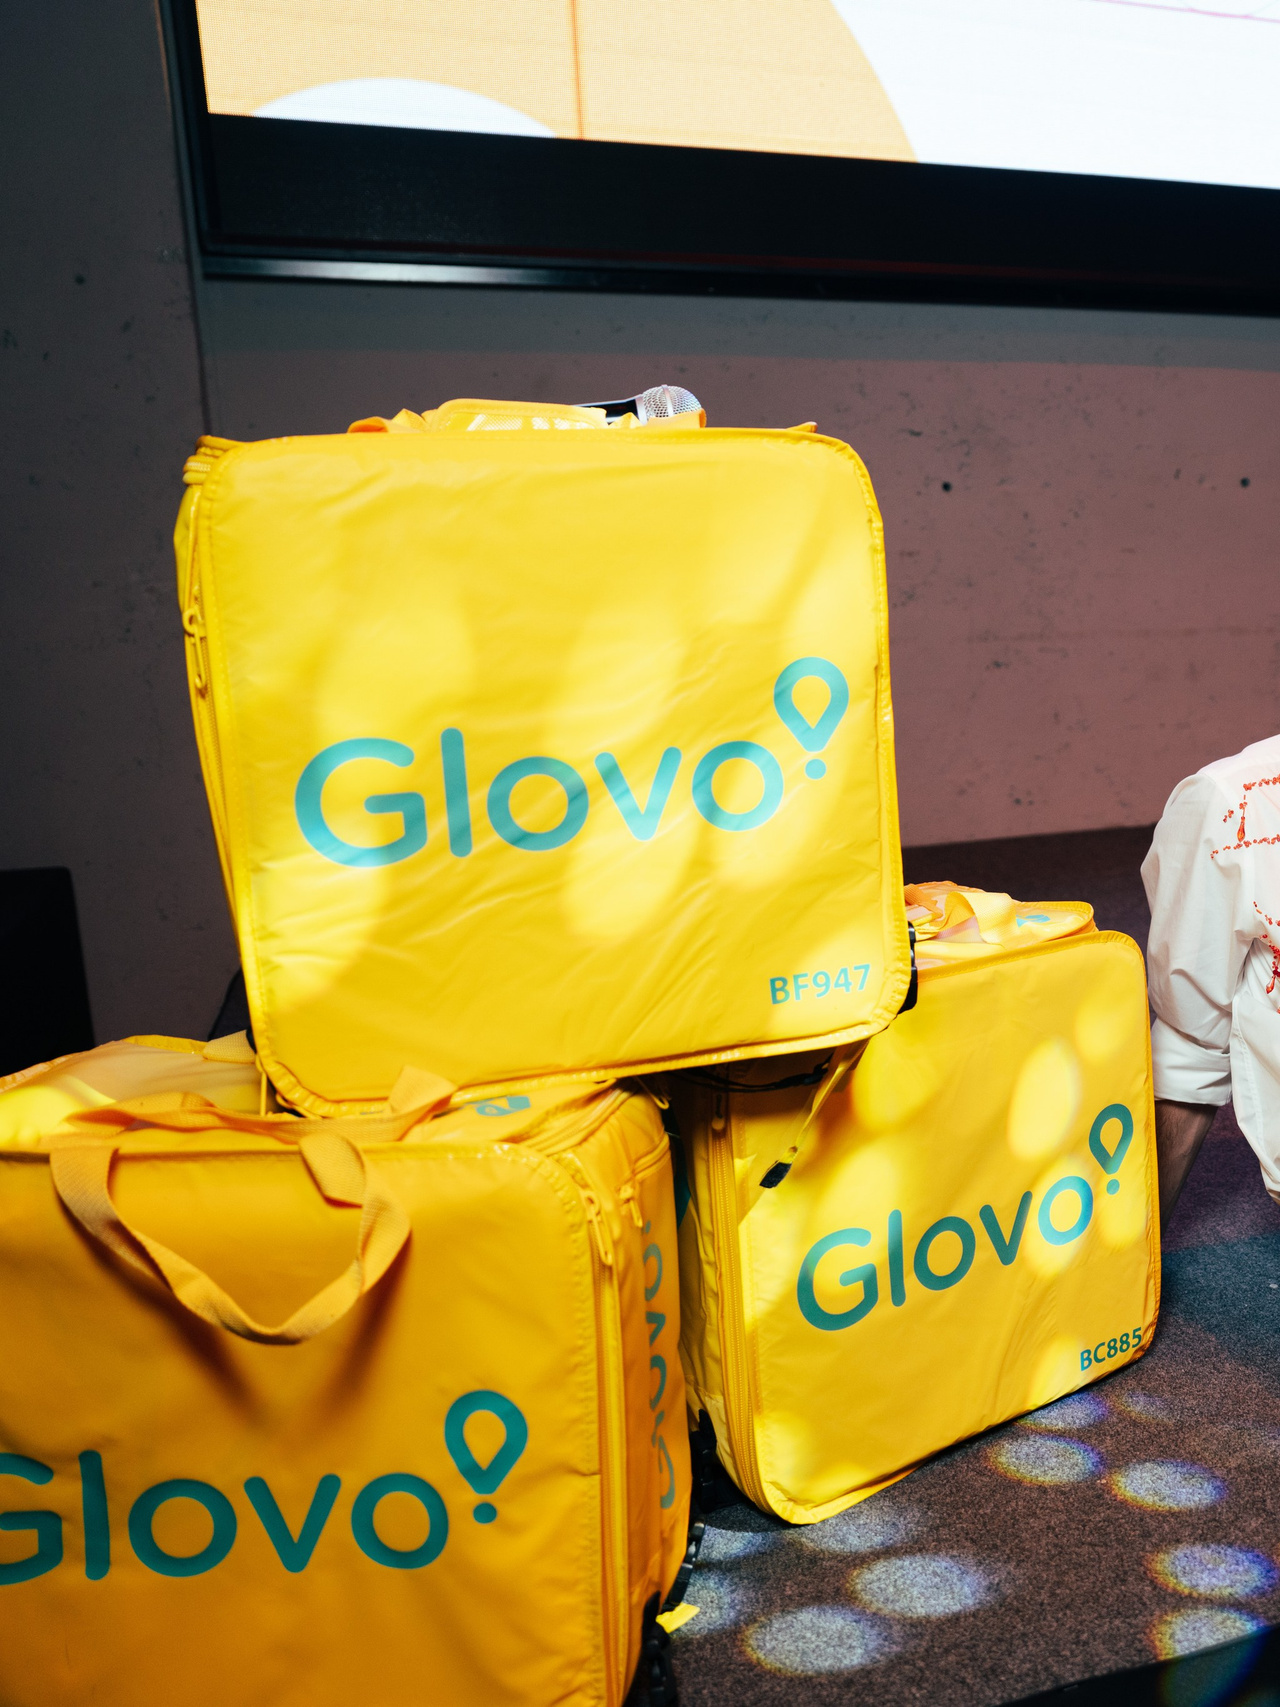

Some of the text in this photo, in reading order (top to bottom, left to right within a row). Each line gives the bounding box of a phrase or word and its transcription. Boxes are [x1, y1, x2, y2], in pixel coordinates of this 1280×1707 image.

[294, 727, 784, 868] Glovo
[769, 963, 870, 1005] BF947
[797, 1175, 1094, 1332] Glovo
[1080, 1326, 1142, 1372] BC885
